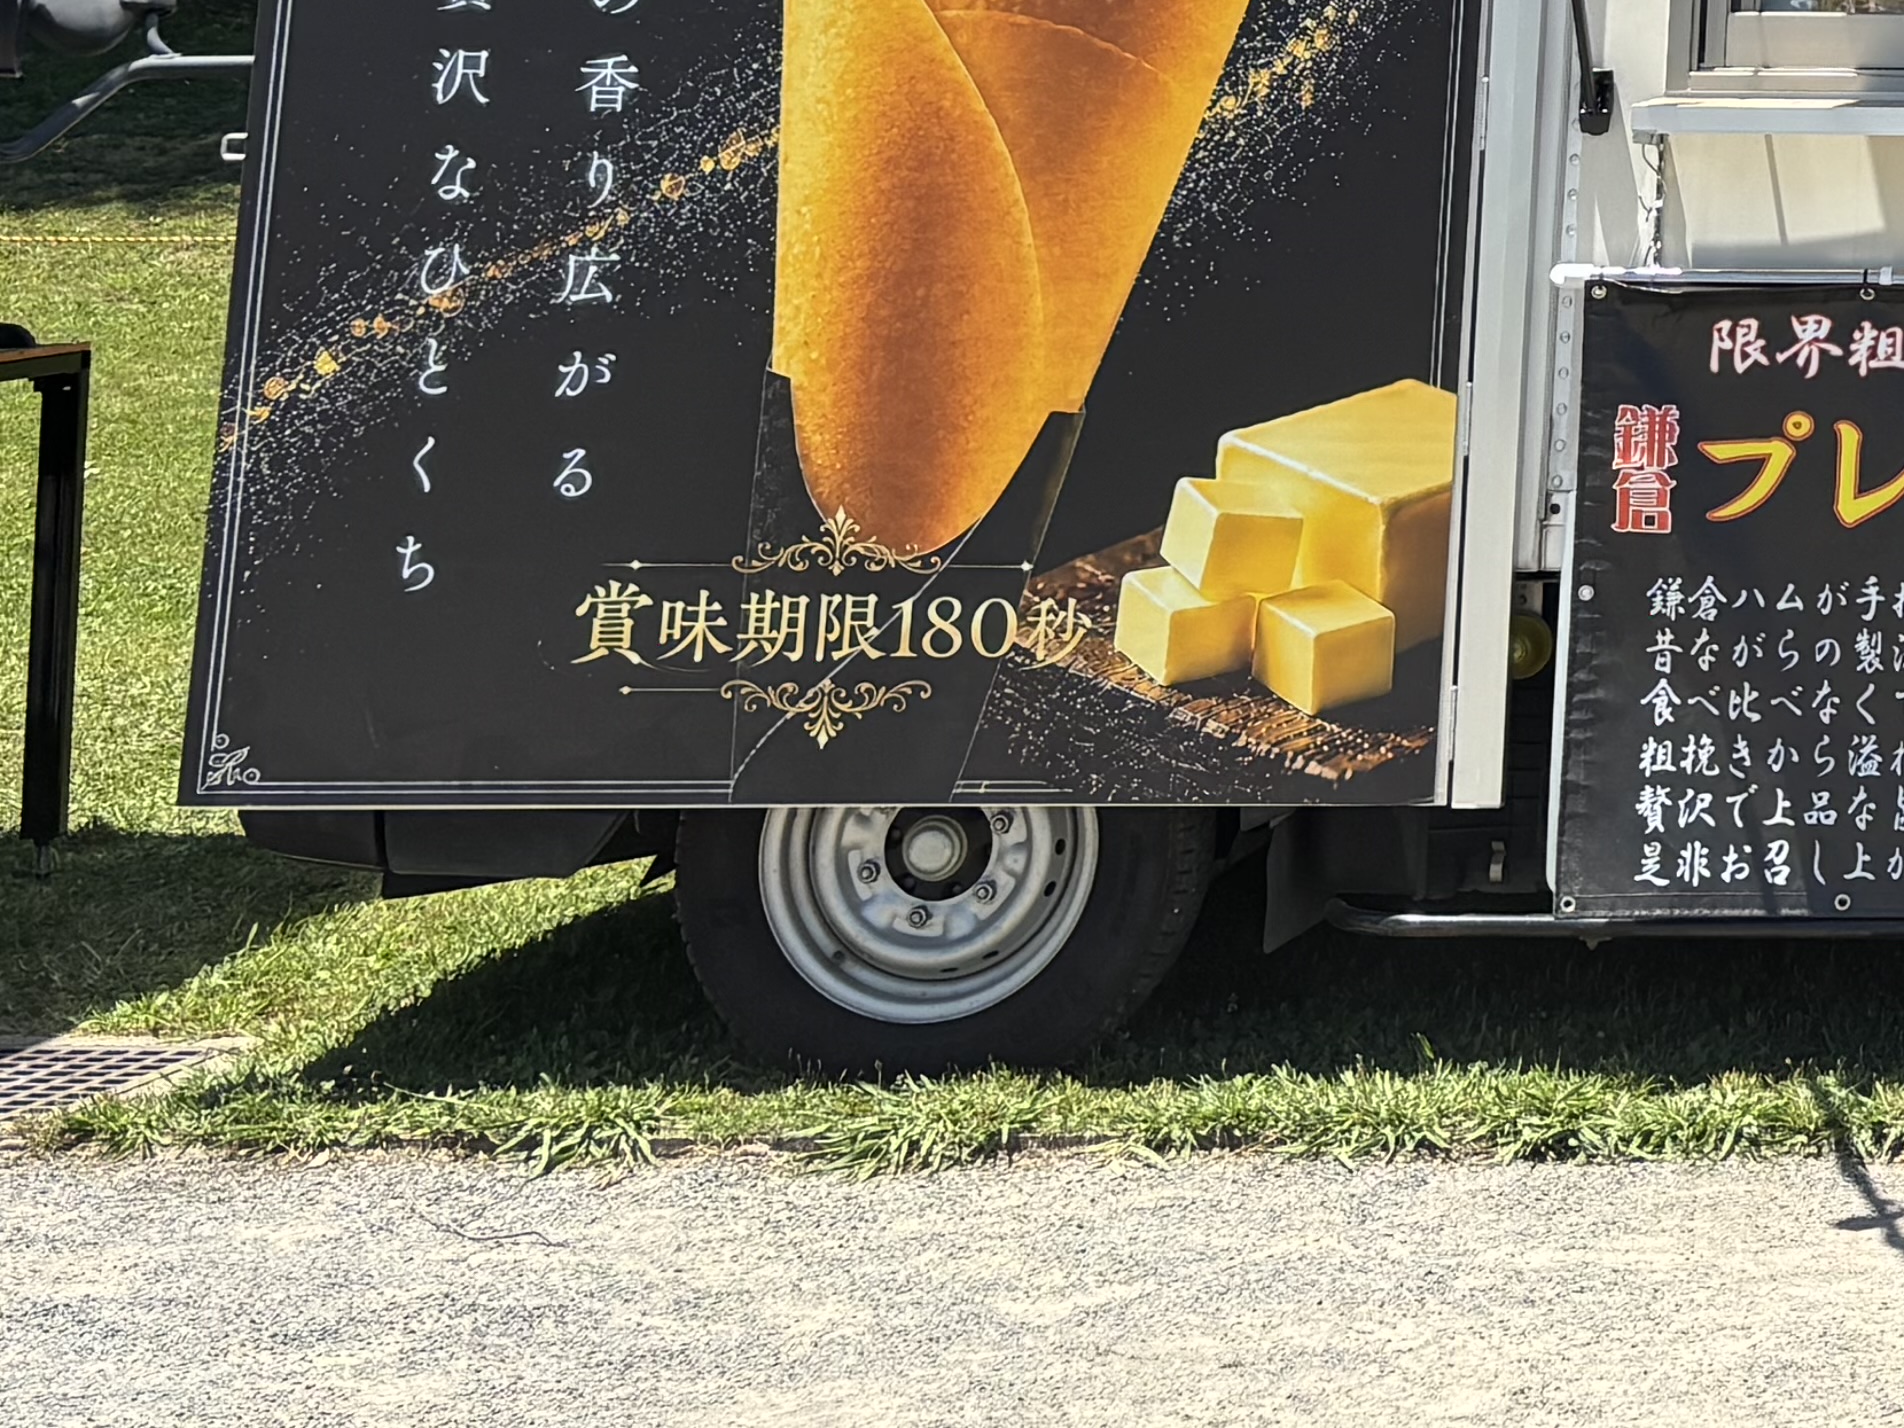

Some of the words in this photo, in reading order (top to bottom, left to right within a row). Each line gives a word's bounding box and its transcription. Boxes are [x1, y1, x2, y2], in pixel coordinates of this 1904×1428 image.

[1611, 402, 1681, 535] 鎌倉
[571, 580, 1095, 672] 賞味期限180秒
